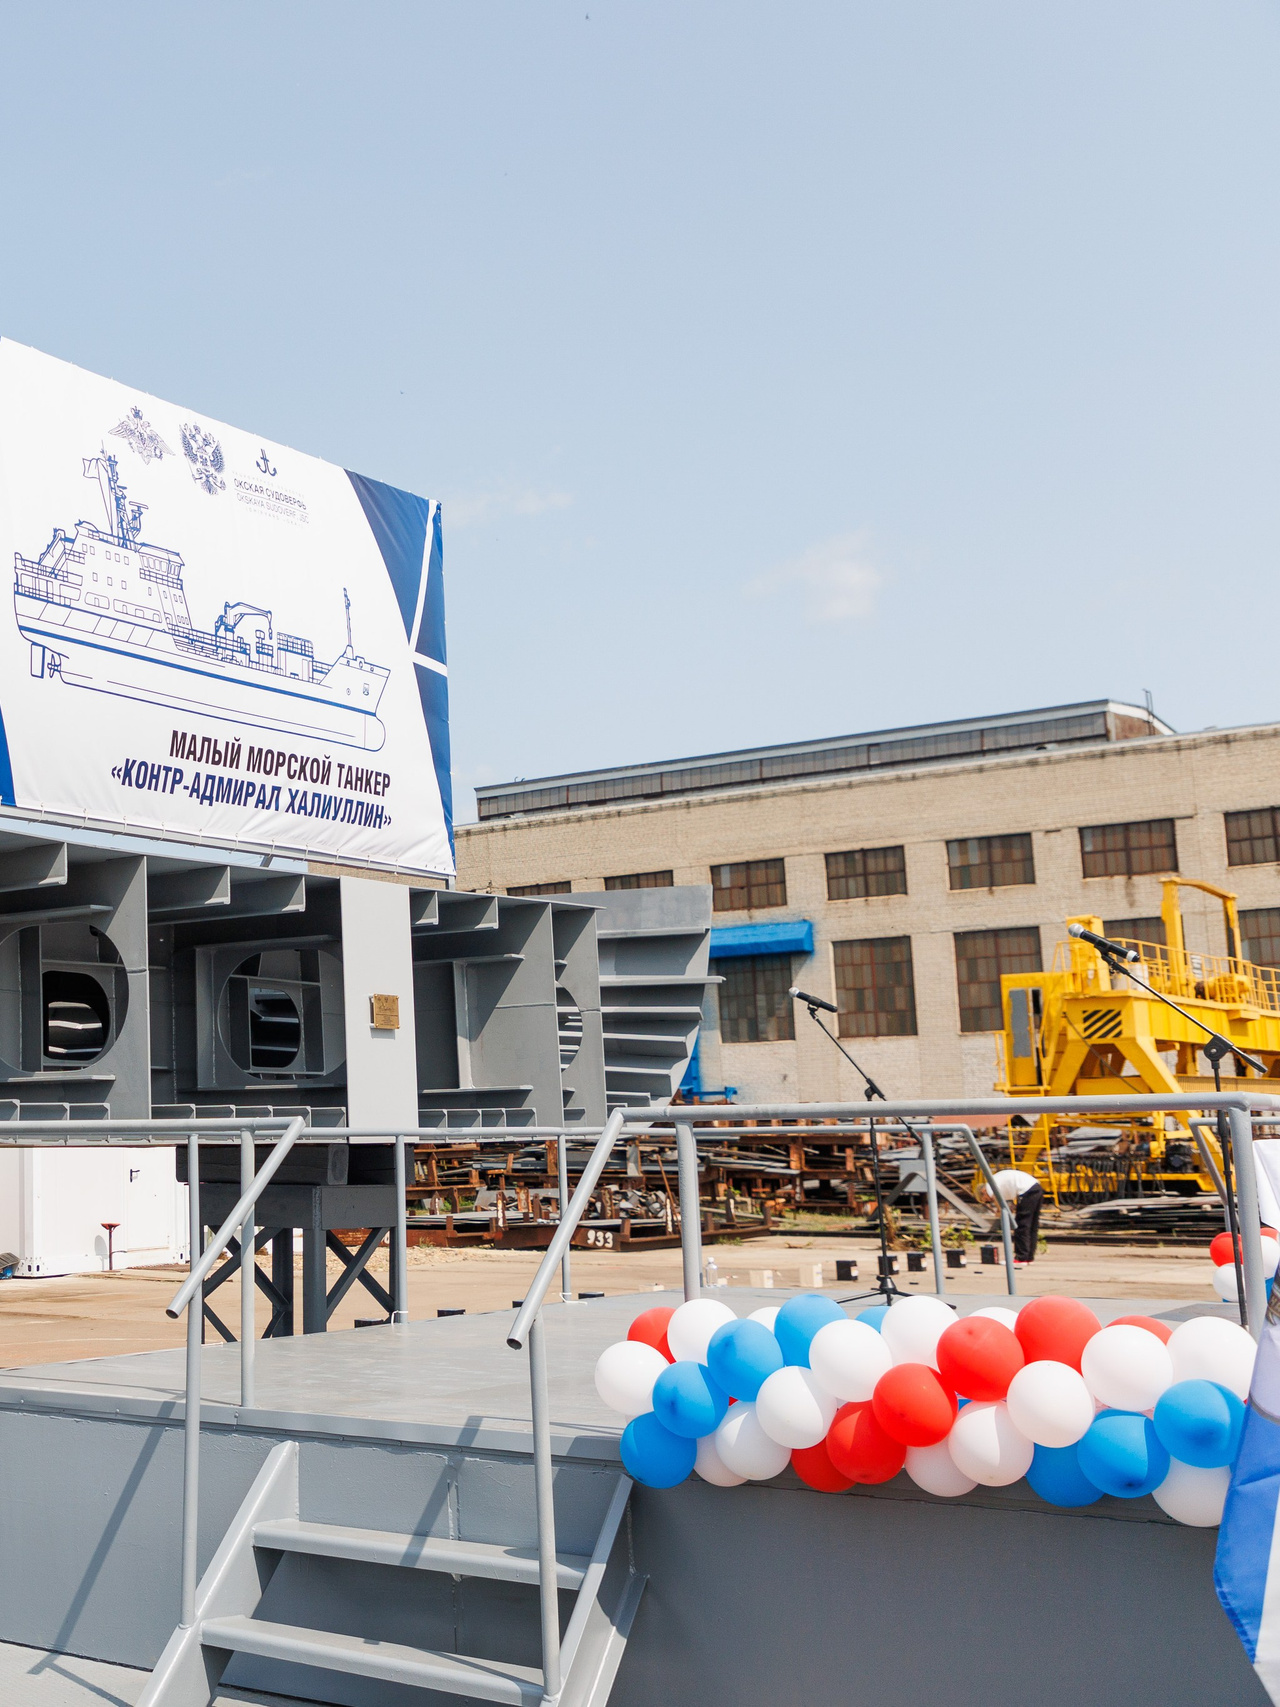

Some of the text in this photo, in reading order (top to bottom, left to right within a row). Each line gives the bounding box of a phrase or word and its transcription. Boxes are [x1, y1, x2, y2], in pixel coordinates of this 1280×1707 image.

[234, 478, 264, 496] ОКСКАЯ
[265, 488, 307, 510] СУДОВЕРФЬ
[169, 730, 391, 797] МАЛЫЙ МОРСКОЙ ТАНКЕР
[111, 758, 392, 829] «КОНТР-АДМИРАЛ ХАЛИУЛЛИН»
[587, 1229, 613, 1248] 933
